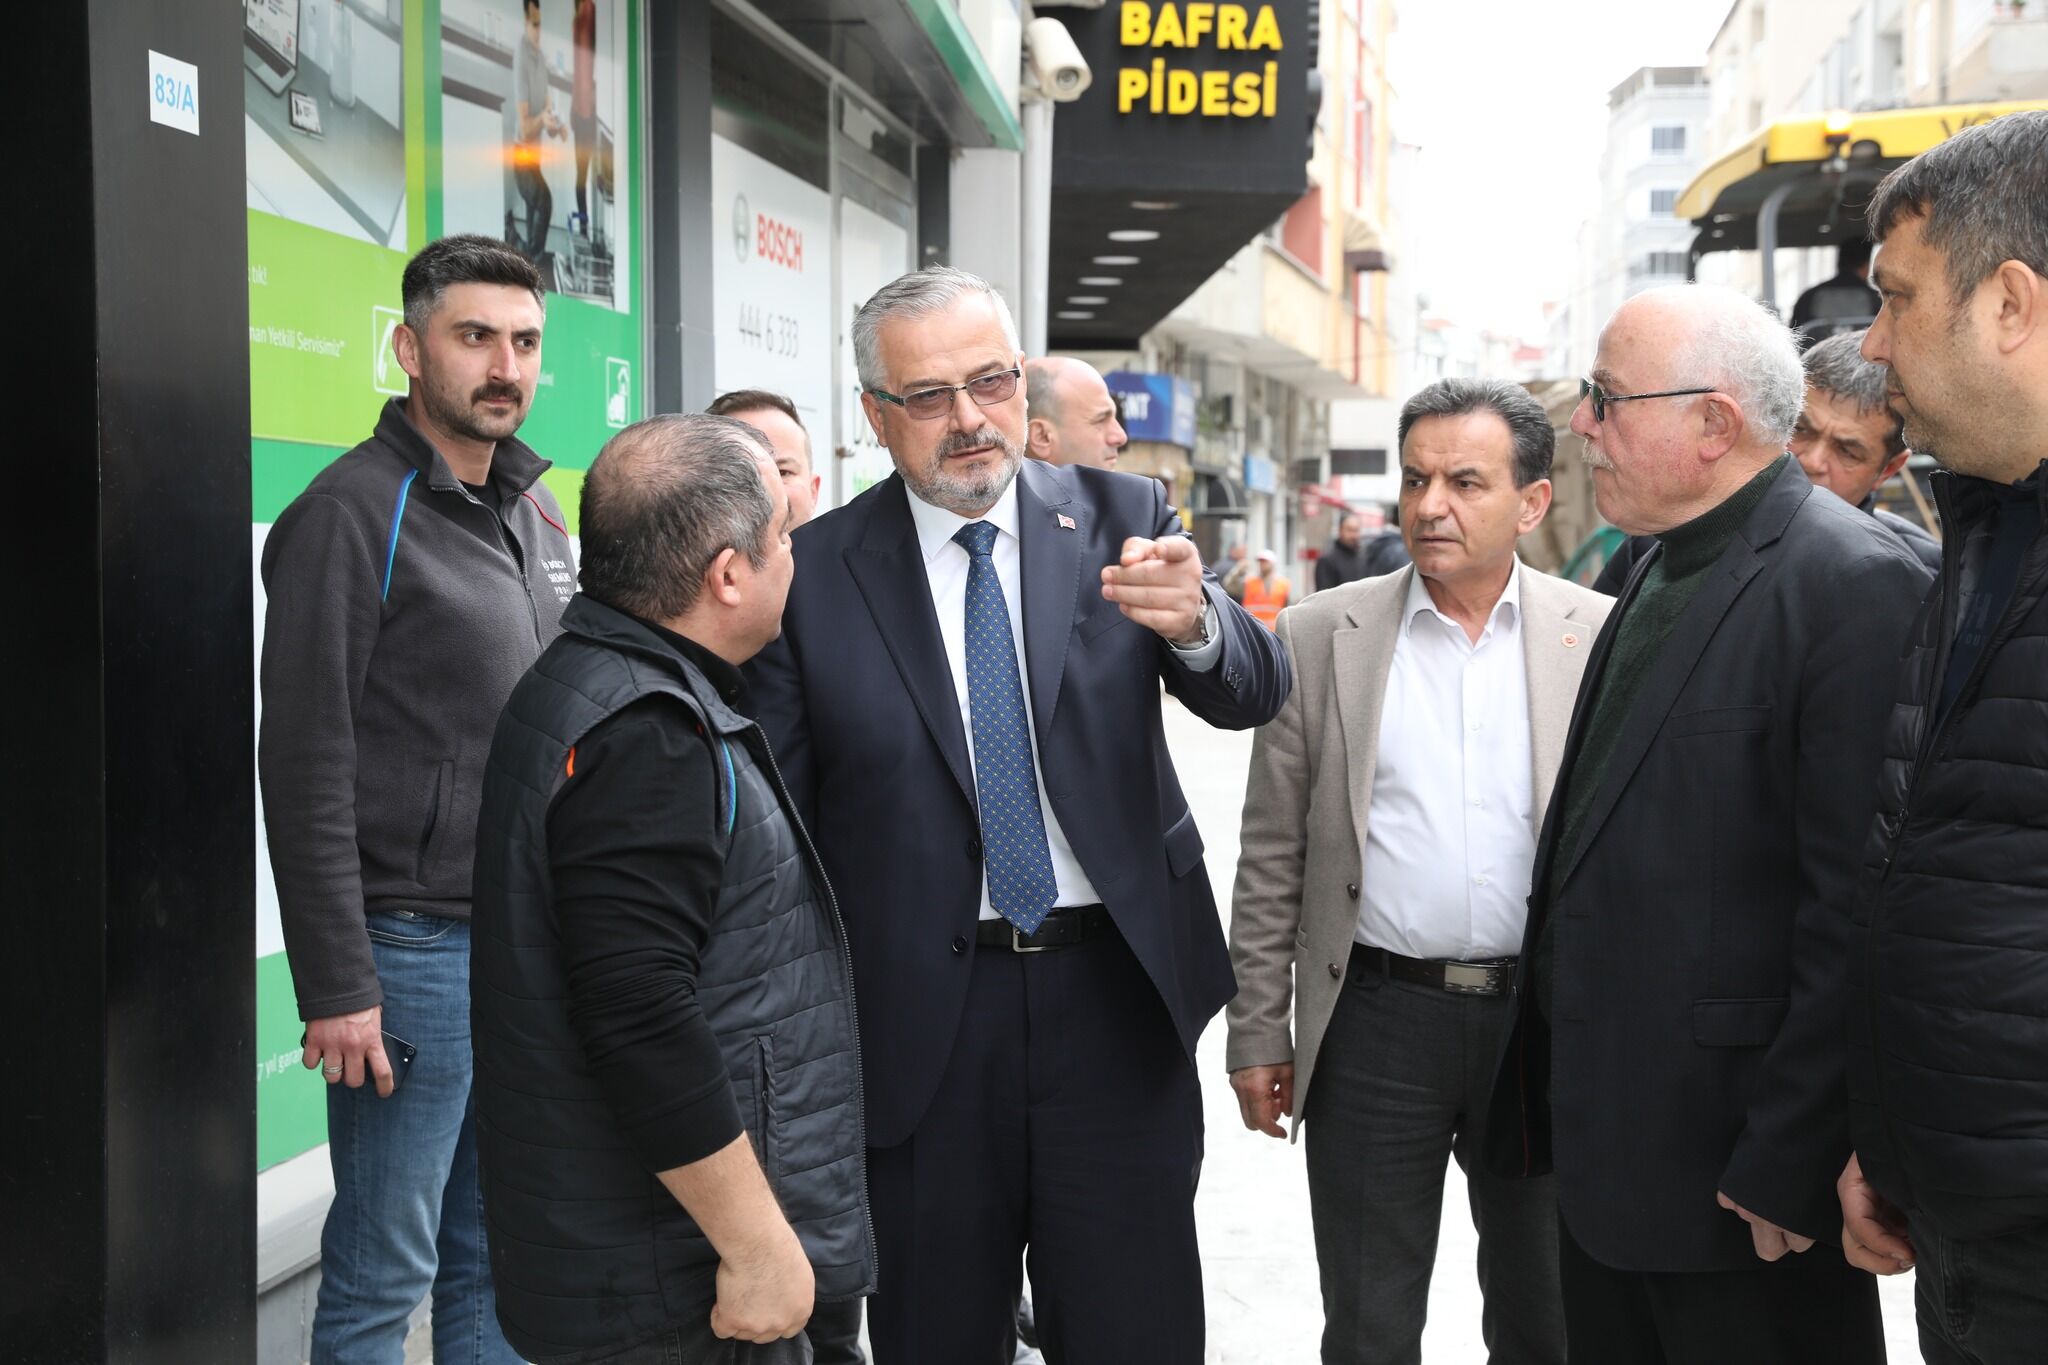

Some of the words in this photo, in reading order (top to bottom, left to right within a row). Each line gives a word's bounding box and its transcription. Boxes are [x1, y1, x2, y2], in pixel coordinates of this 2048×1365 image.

[1120, 1, 1283, 50] BAFRA
[155, 72, 196, 115] 83/A
[1118, 57, 1278, 117] PİDESİ
[758, 213, 803, 273] BOSCH
[267, 326, 296, 349] Yetkili
[739, 302, 762, 348] 444
[766, 313, 774, 352] 6
[777, 315, 799, 358] 333
